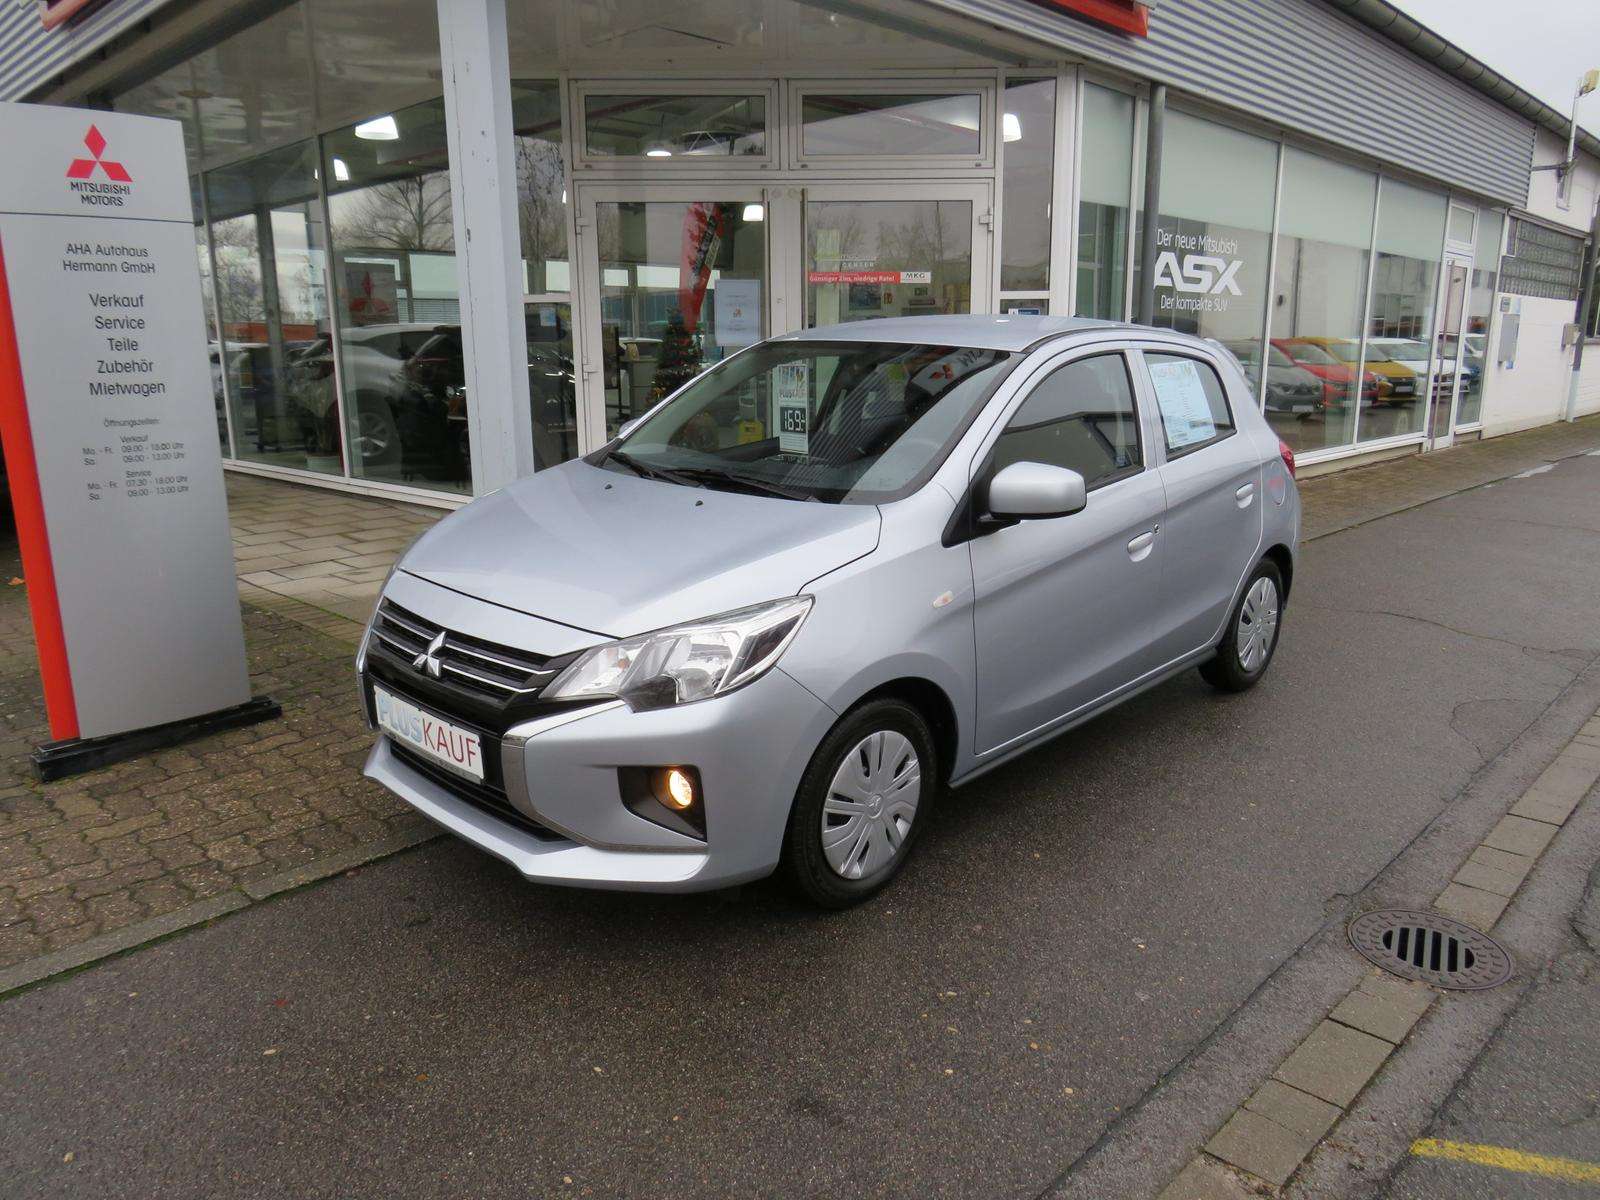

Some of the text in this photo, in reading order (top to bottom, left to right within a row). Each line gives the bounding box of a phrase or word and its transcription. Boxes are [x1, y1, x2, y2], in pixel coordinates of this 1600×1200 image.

[70, 182, 130, 195] MITSUBISHI
[81, 195, 124, 206] MOTORS
[1157, 228, 1238, 255] Der neue Mitsubishi
[66, 243, 149, 257] AHA Autohaus
[62, 261, 155, 274] Hermann GmbH
[1153, 251, 1244, 296] ASX
[89, 293, 145, 308] Verkauf
[1160, 294, 1229, 312] Der kompakte SUV
[94, 315, 145, 330] Service
[107, 338, 139, 352] Teile
[97, 359, 154, 374] Zubehör
[89, 382, 166, 397] Mietwagen
